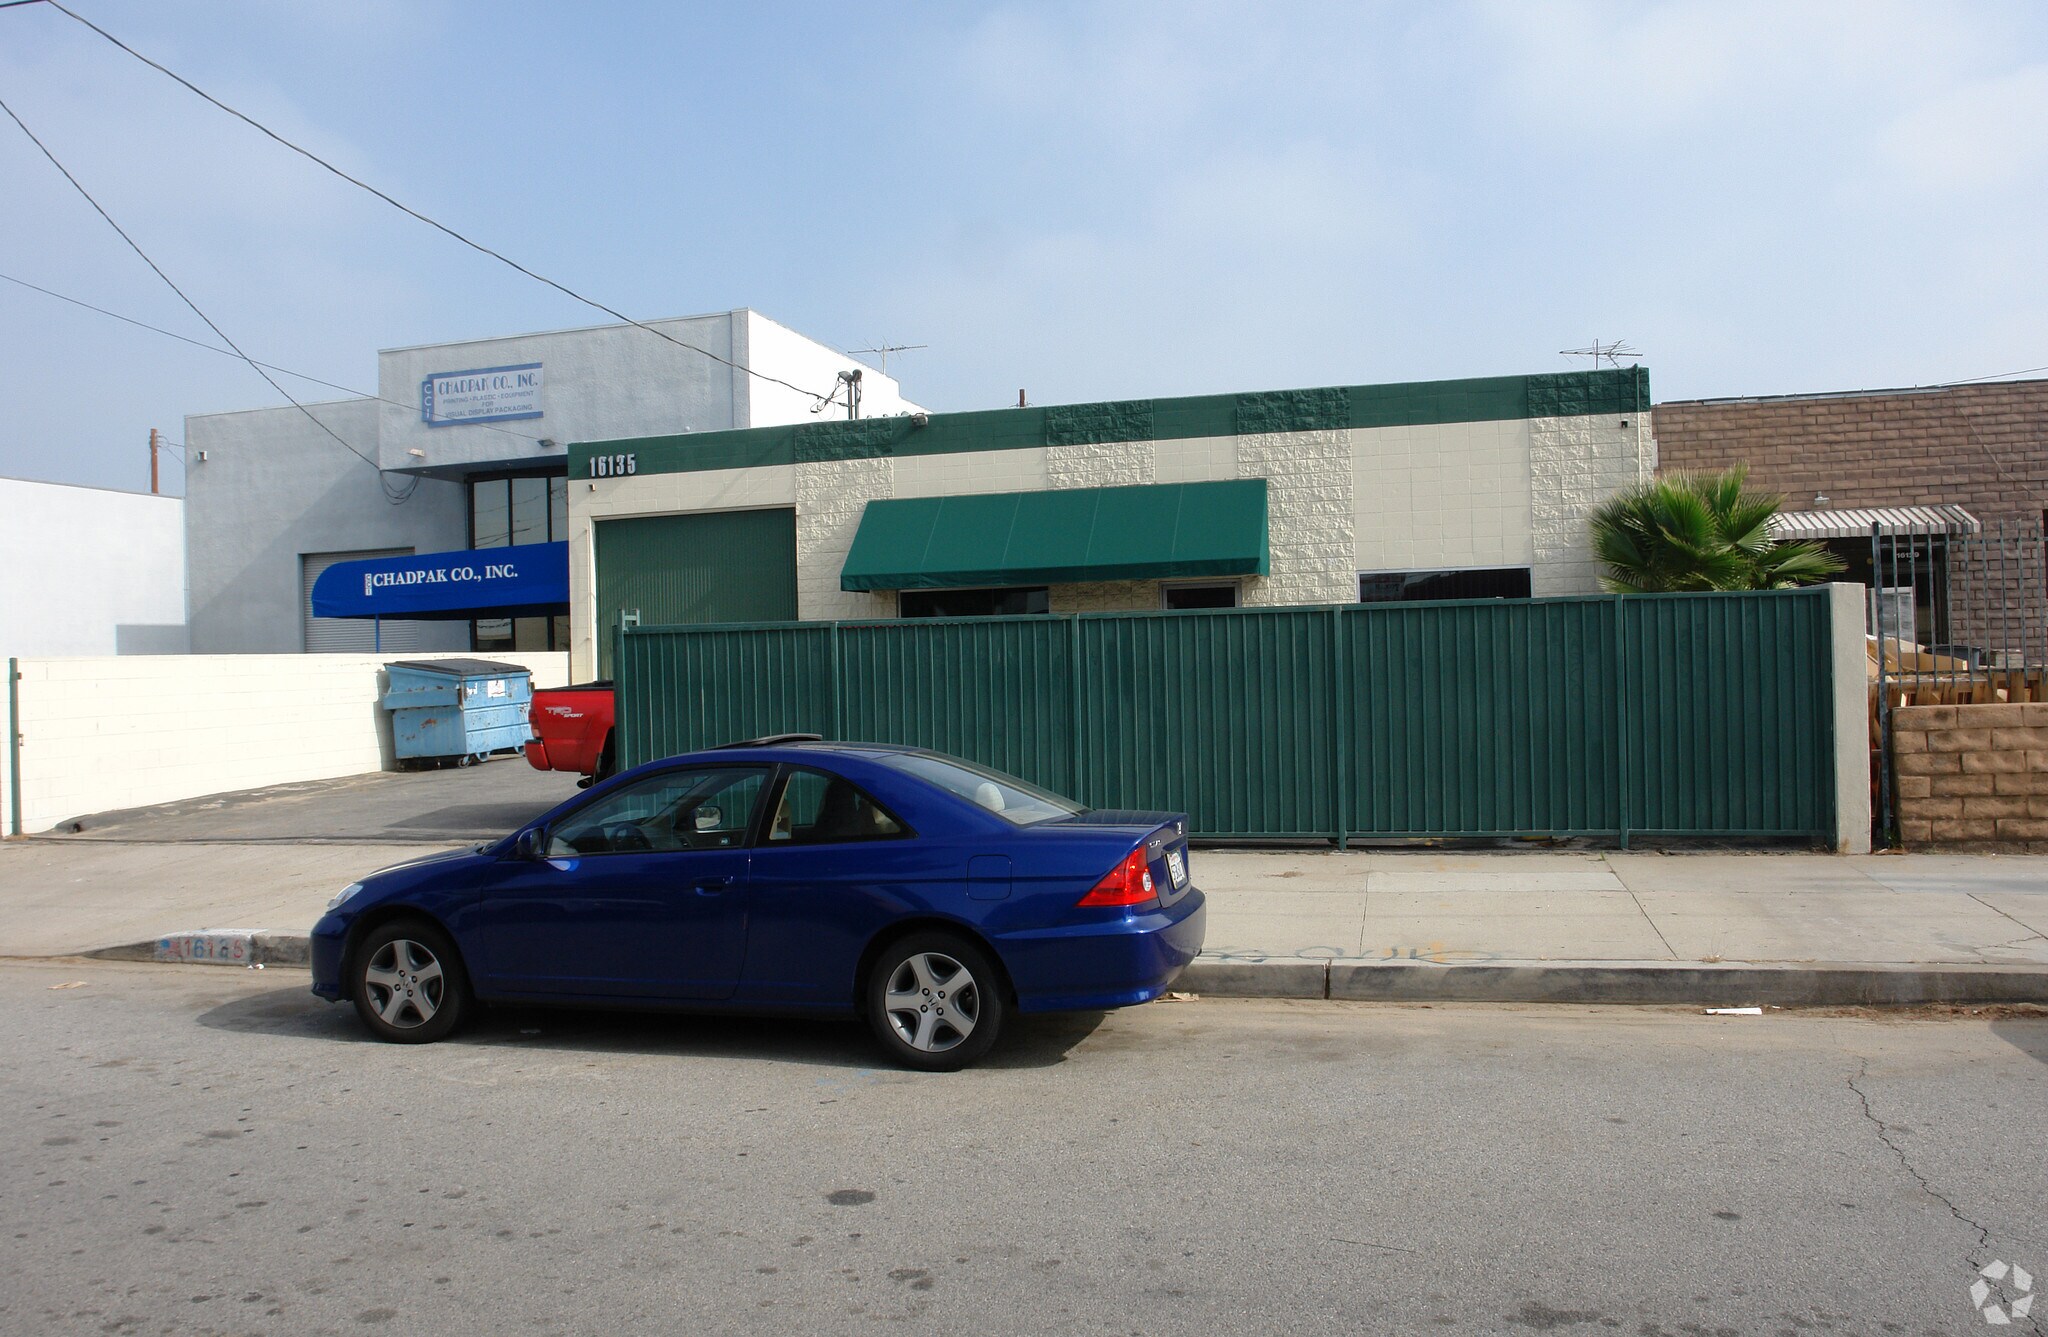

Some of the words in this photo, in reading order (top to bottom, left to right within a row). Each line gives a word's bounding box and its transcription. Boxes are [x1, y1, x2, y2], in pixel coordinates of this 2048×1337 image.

[438, 377, 490, 395] CHADPAK
[517, 372, 538, 388] INC.
[500, 391, 534, 399] EQUIPMENT
[468, 408, 494, 416] DISPLAY
[494, 404, 533, 414] PACKAGING
[590, 453, 636, 477] 16135
[373, 569, 448, 587] CHADPAK
[451, 566, 482, 582] CO.,
[485, 564, 518, 579] INC.
